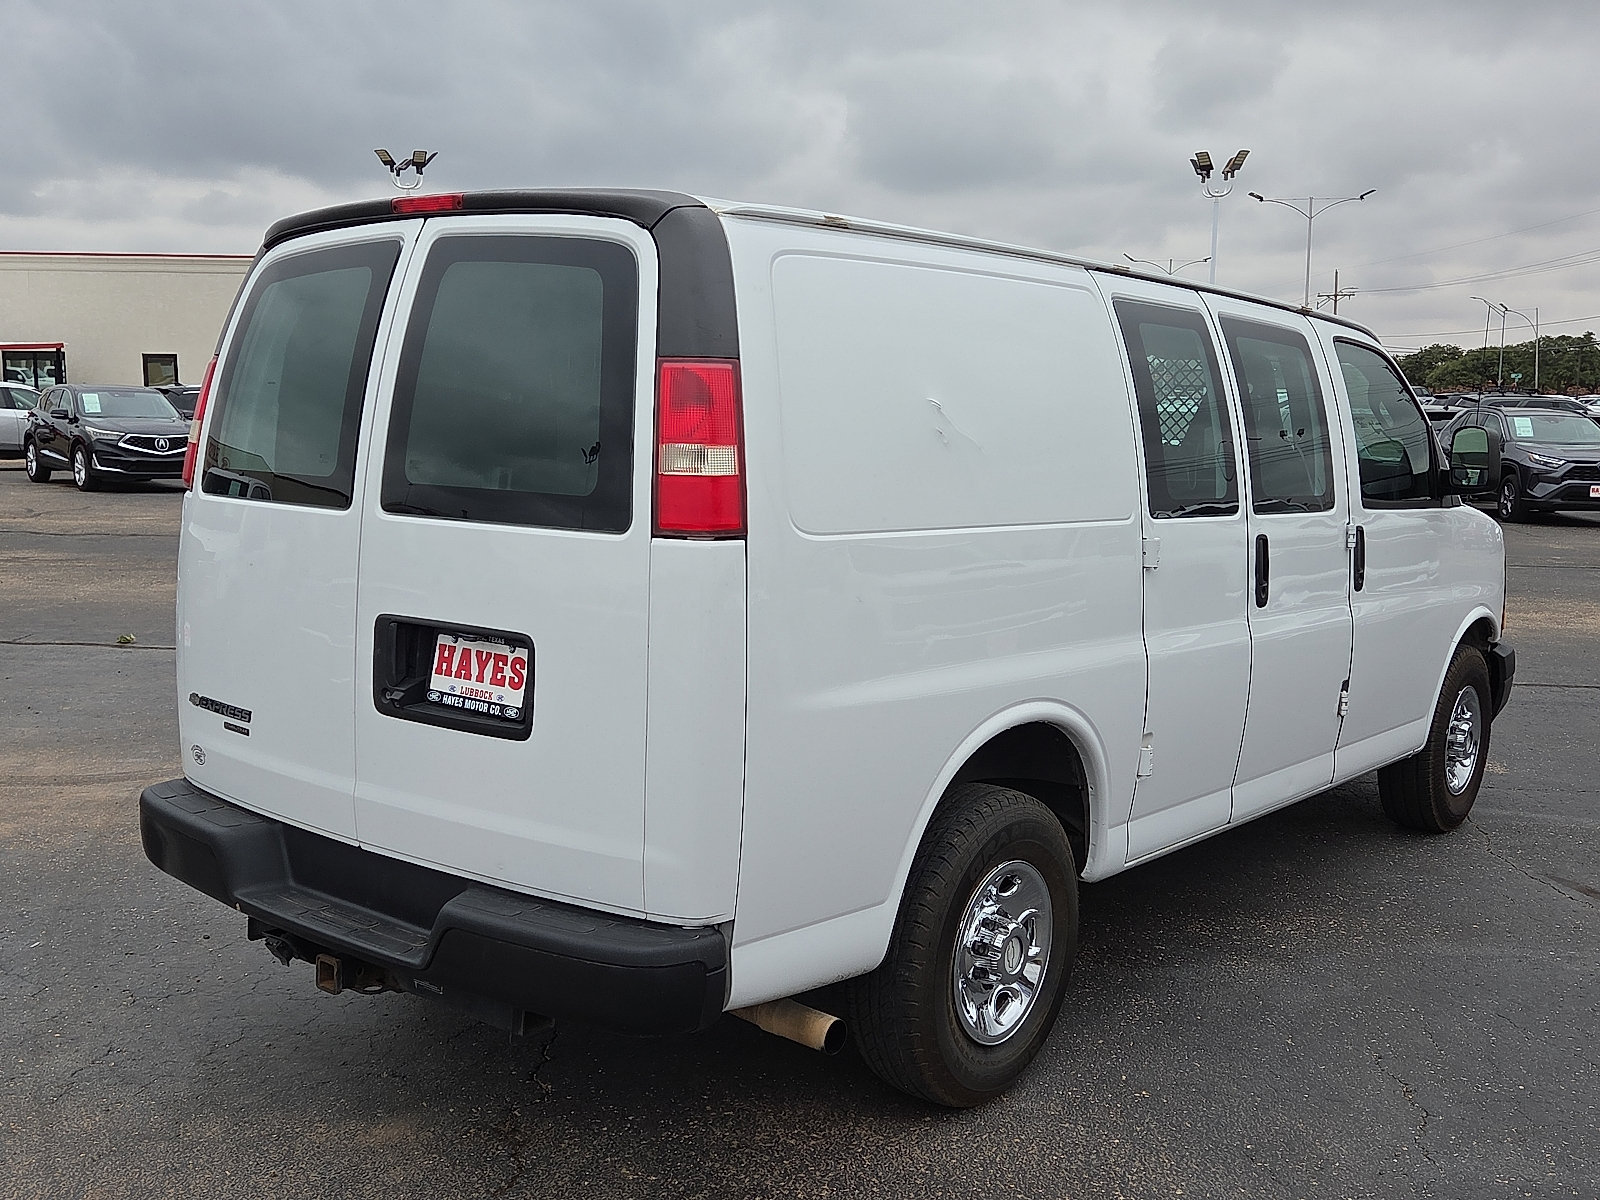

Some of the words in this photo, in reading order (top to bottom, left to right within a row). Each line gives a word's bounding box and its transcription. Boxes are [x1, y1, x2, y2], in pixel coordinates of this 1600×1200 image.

[488, 636, 505, 645] TEXAS
[435, 643, 526, 691] HAYES
[460, 686, 494, 701] LUBBOCK
[200, 696, 251, 723] EXPRESS
[442, 694, 464, 707] HAYES
[464, 698, 488, 713] MOTOR
[489, 705, 502, 716] CO.
